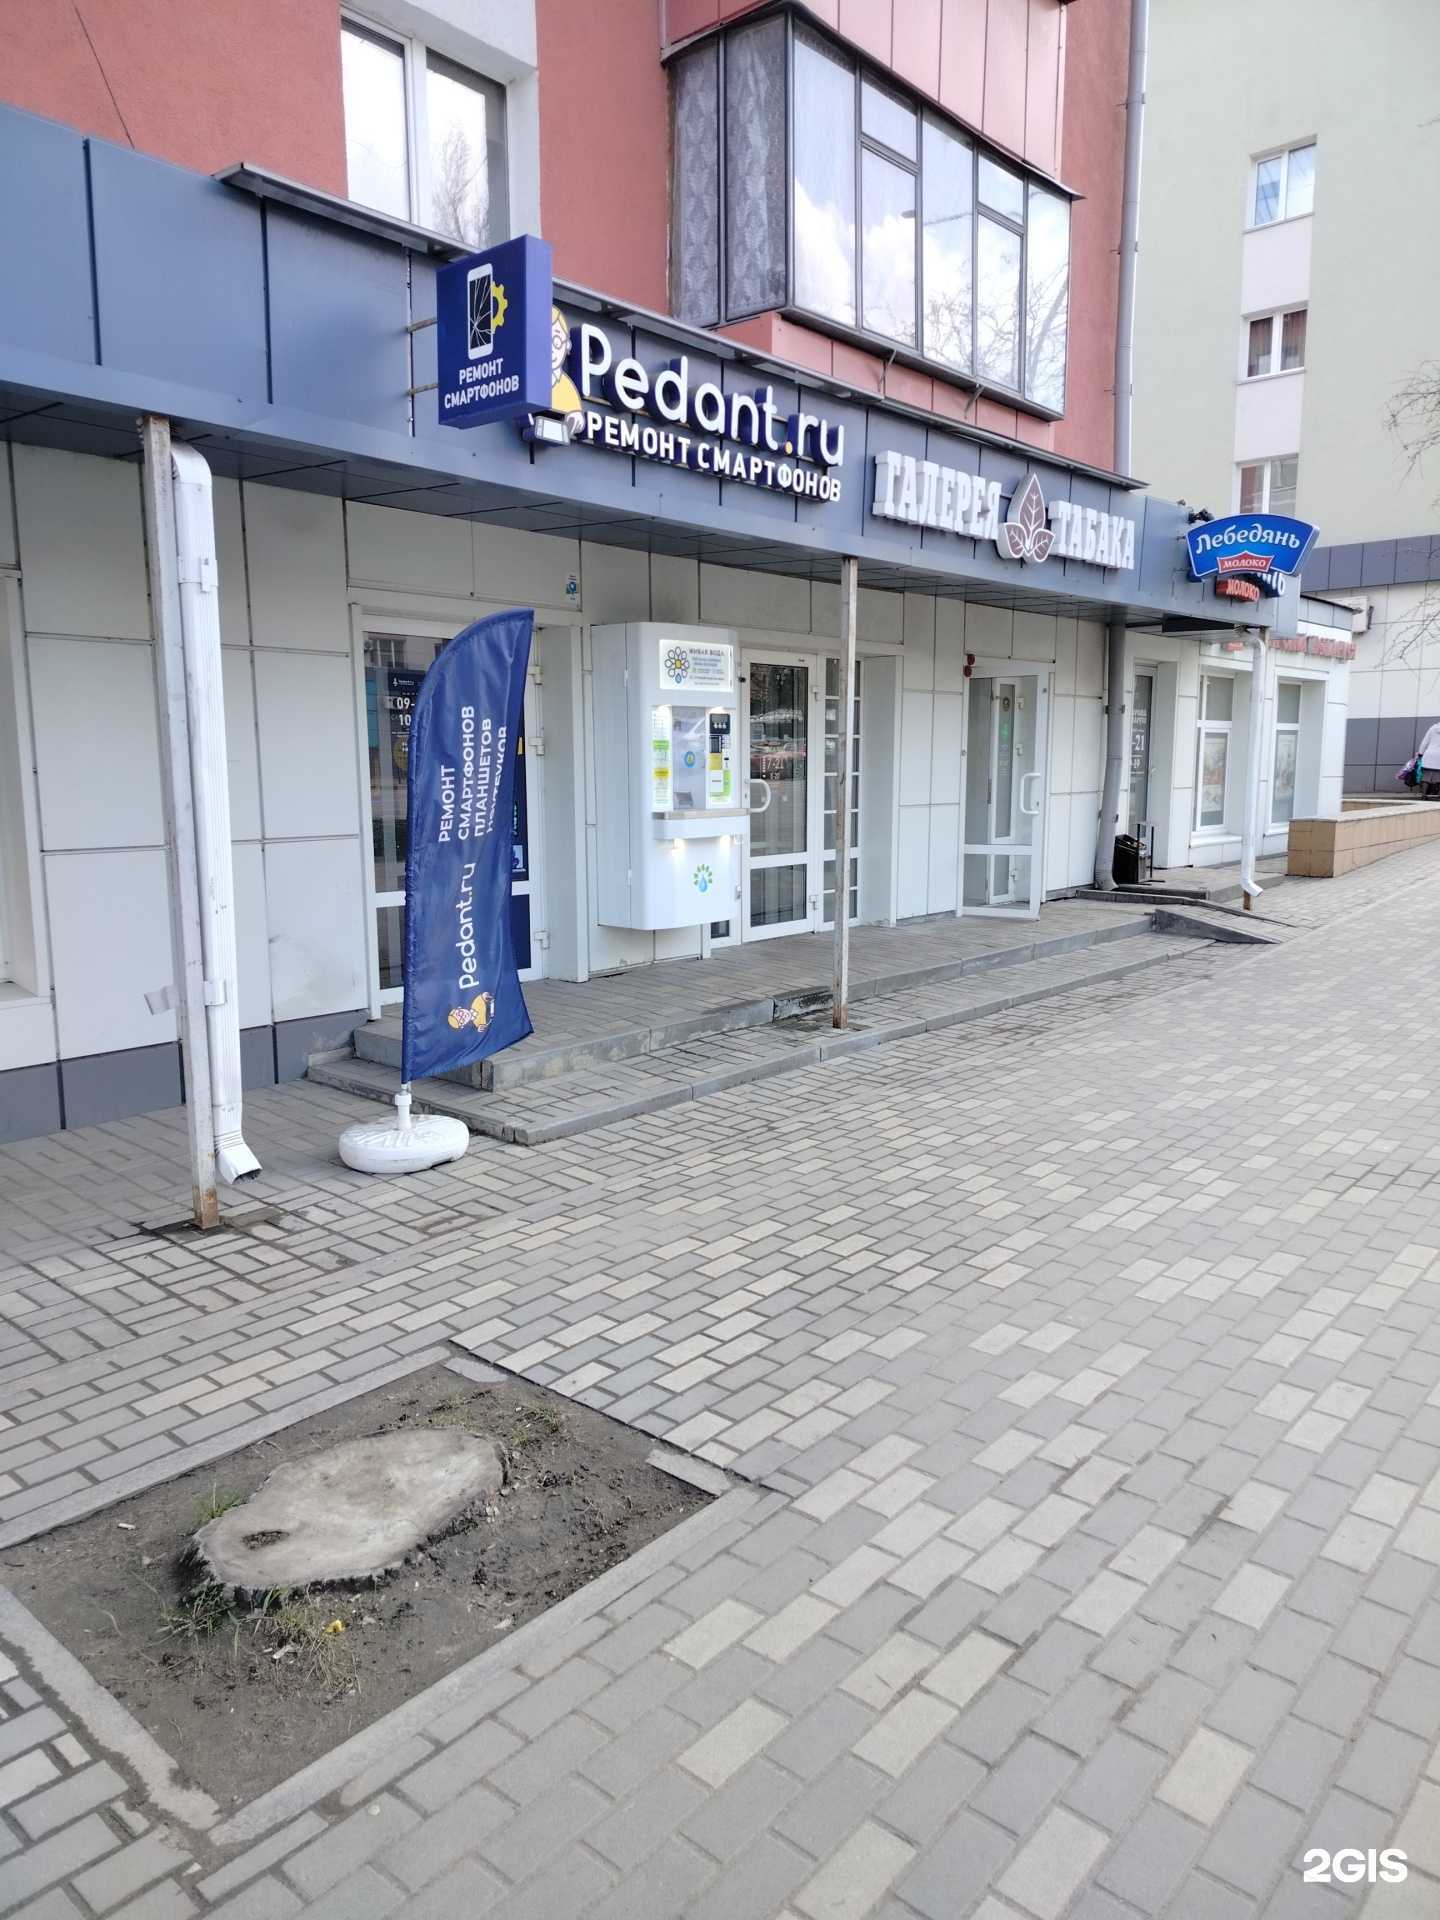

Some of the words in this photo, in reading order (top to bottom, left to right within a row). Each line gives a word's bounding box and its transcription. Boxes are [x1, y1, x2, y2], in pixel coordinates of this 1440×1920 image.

[444, 374, 520, 409] СМАРТФОНОВ
[458, 357, 504, 385] РЕМОНТ
[580, 322, 845, 467] Pedant.ru
[586, 410, 691, 465] РЕМОНТ
[697, 442, 843, 502] СМАРТФОНОВ
[873, 449, 1003, 540] ГАЛЕРЕЯ
[1048, 500, 1136, 570] ТАБАКА
[1195, 522, 1301, 554] Лебедянь
[439, 764, 456, 842] РЕМОНТ
[457, 705, 476, 841] СМАРТФОНОВ
[474, 717, 493, 837] ПЛАНШЕТОВ
[455, 862, 480, 990] pedant.ru
